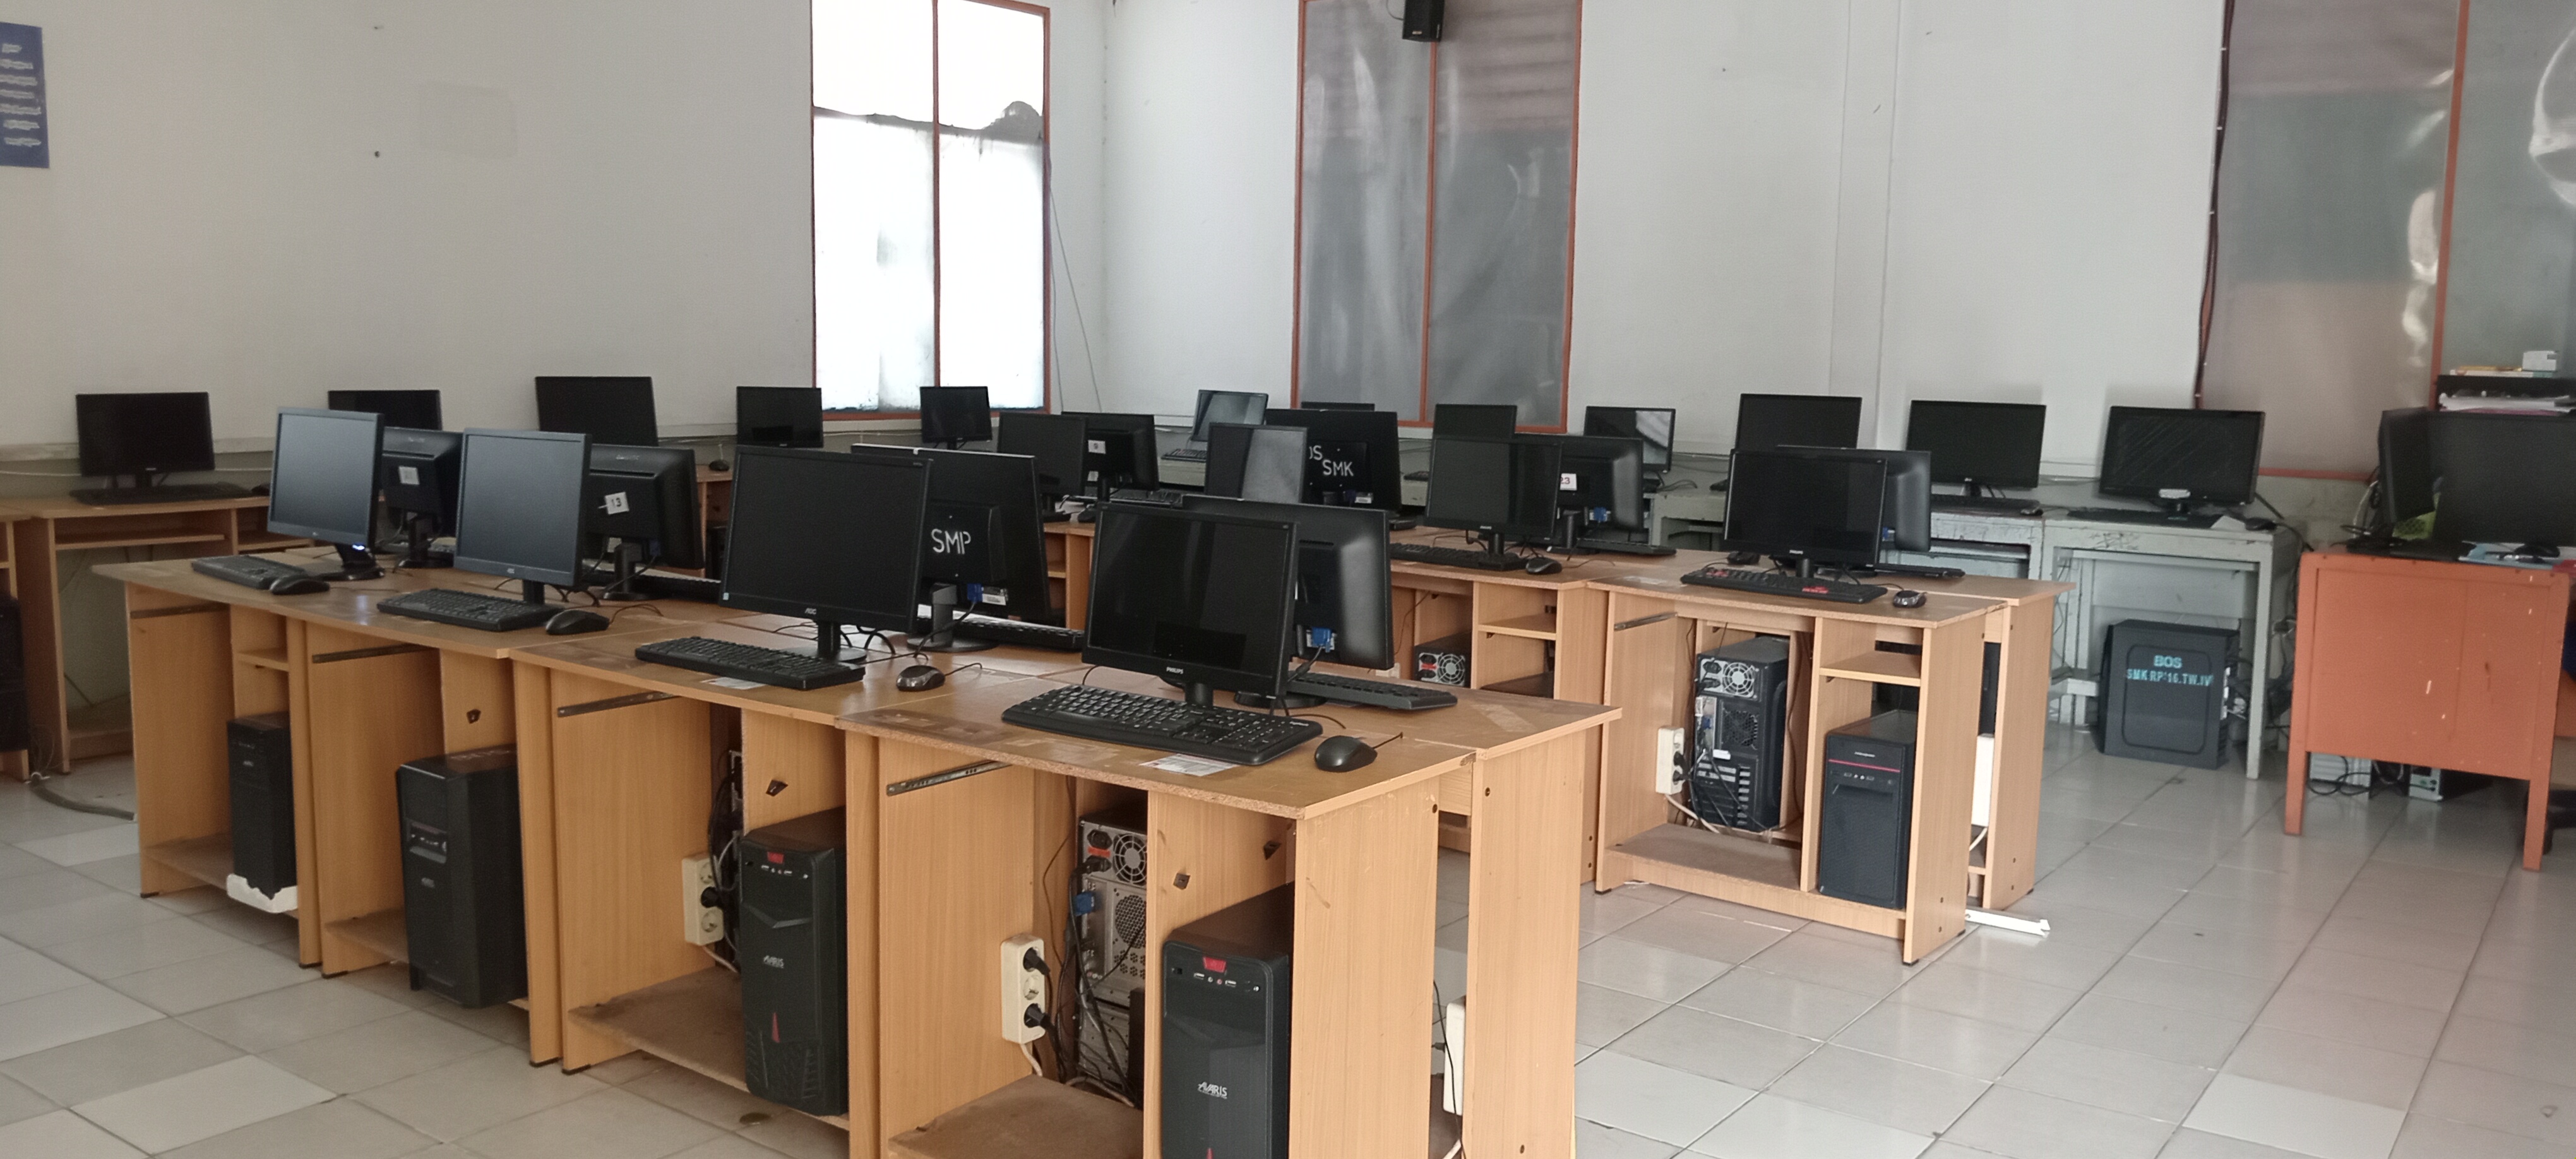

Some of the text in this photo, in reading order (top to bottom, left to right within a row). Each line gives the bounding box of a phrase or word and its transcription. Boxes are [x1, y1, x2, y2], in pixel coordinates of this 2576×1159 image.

[1322, 459, 1354, 477] SMK
[931, 528, 971, 554] SMP
[2154, 655, 2183, 669] BOS
[1198, 1081, 1227, 1097] AVARIS
